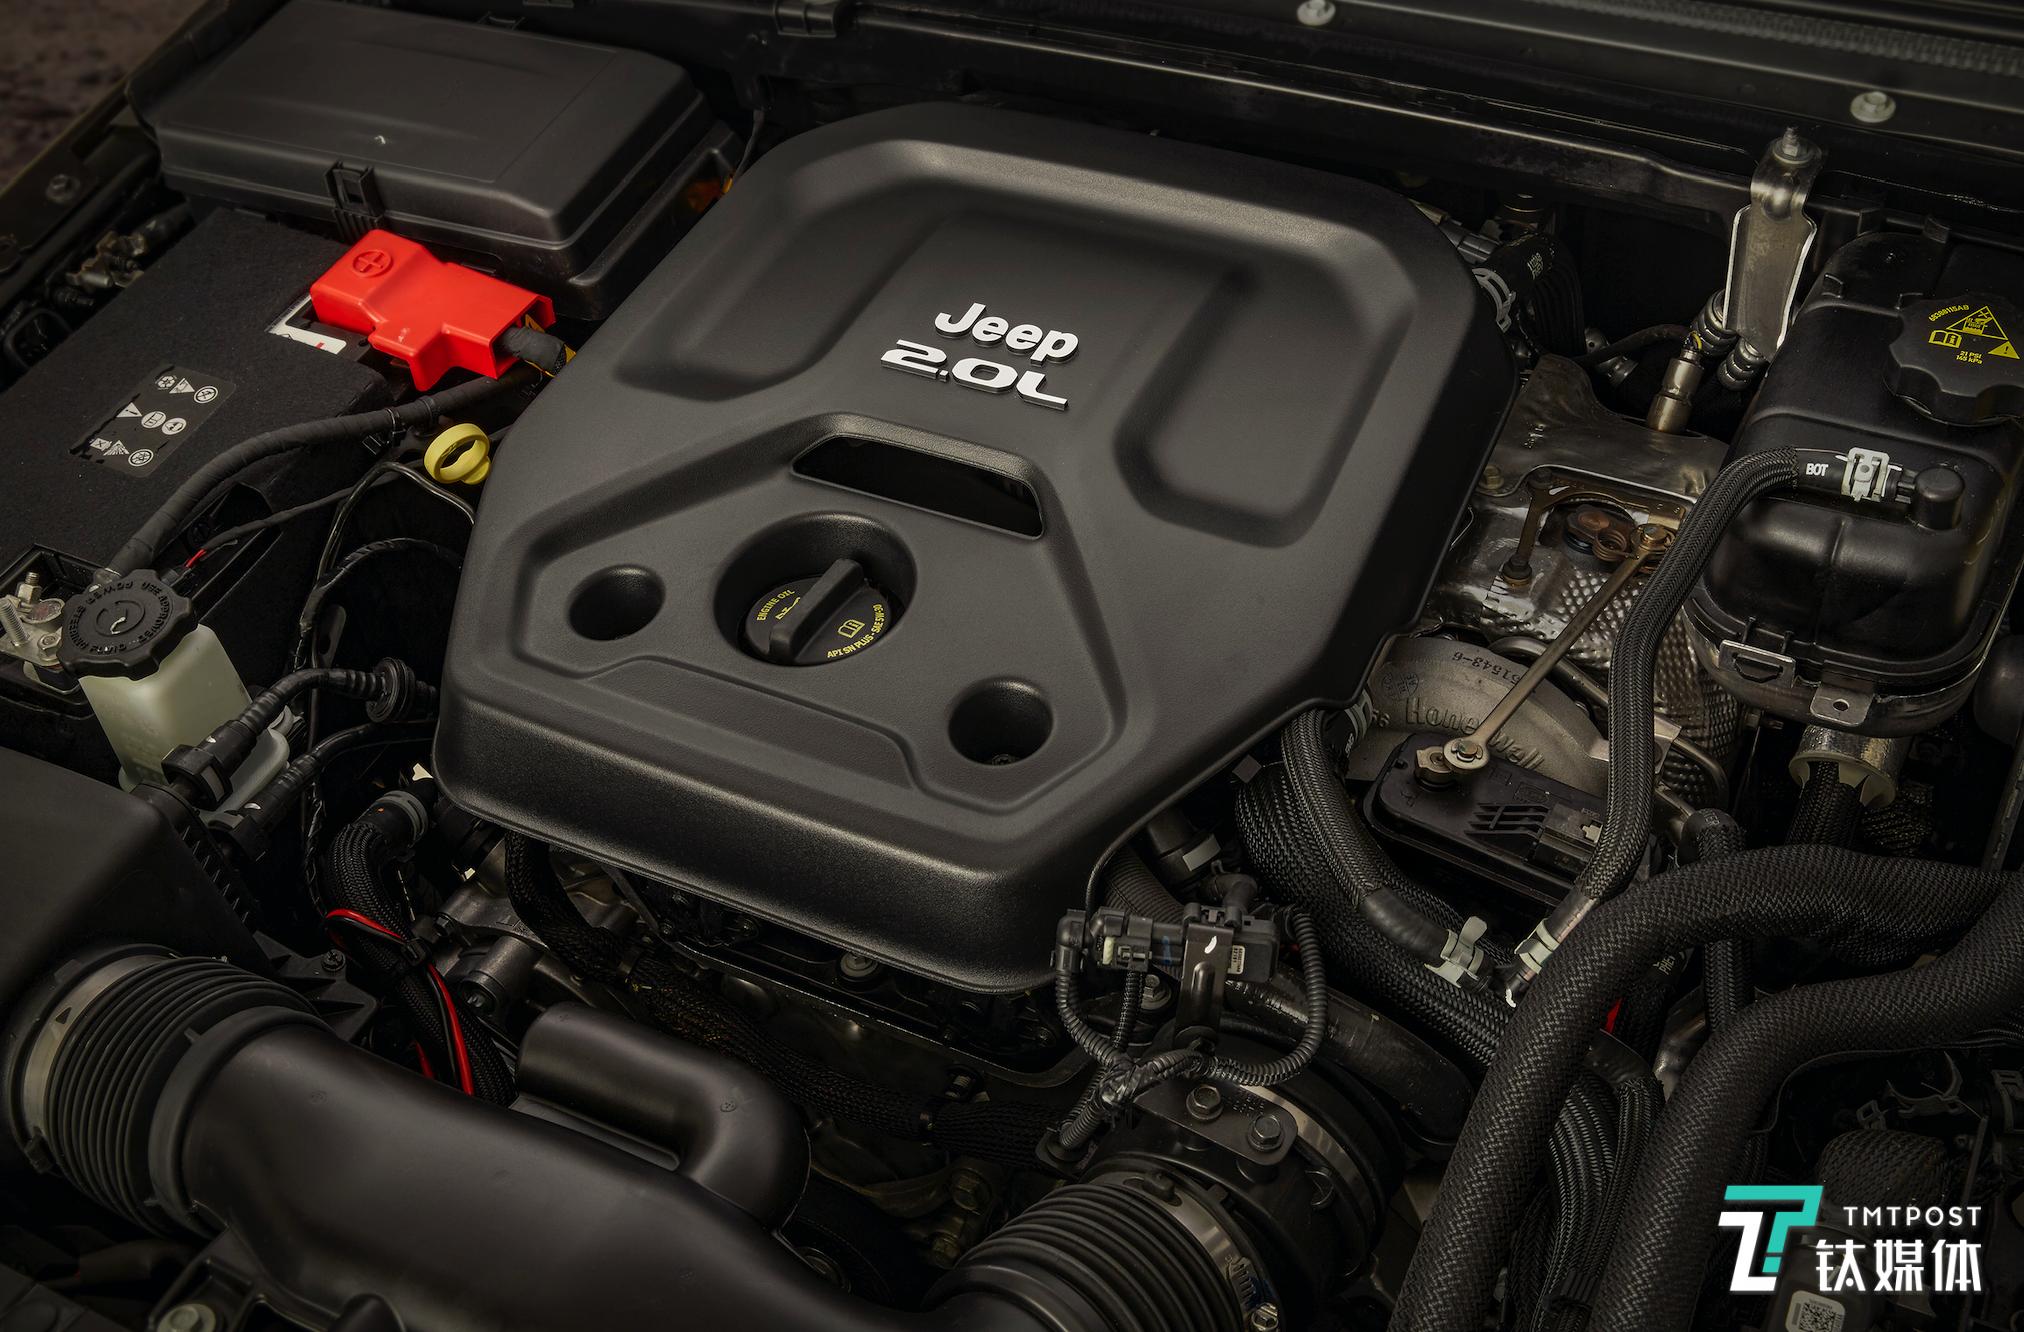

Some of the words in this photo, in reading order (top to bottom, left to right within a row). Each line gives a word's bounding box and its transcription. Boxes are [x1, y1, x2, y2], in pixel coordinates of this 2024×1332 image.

[934, 302, 1079, 367] Jeep
[881, 339, 1068, 411] 2.0L
[1805, 463, 1829, 476] BOT
[756, 596, 779, 621] ENGINE
[778, 588, 796, 600] OIL
[826, 650, 844, 658] API
[843, 643, 856, 654] SN
[853, 634, 874, 649] PLUS
[1406, 697, 1545, 770] Honewell
